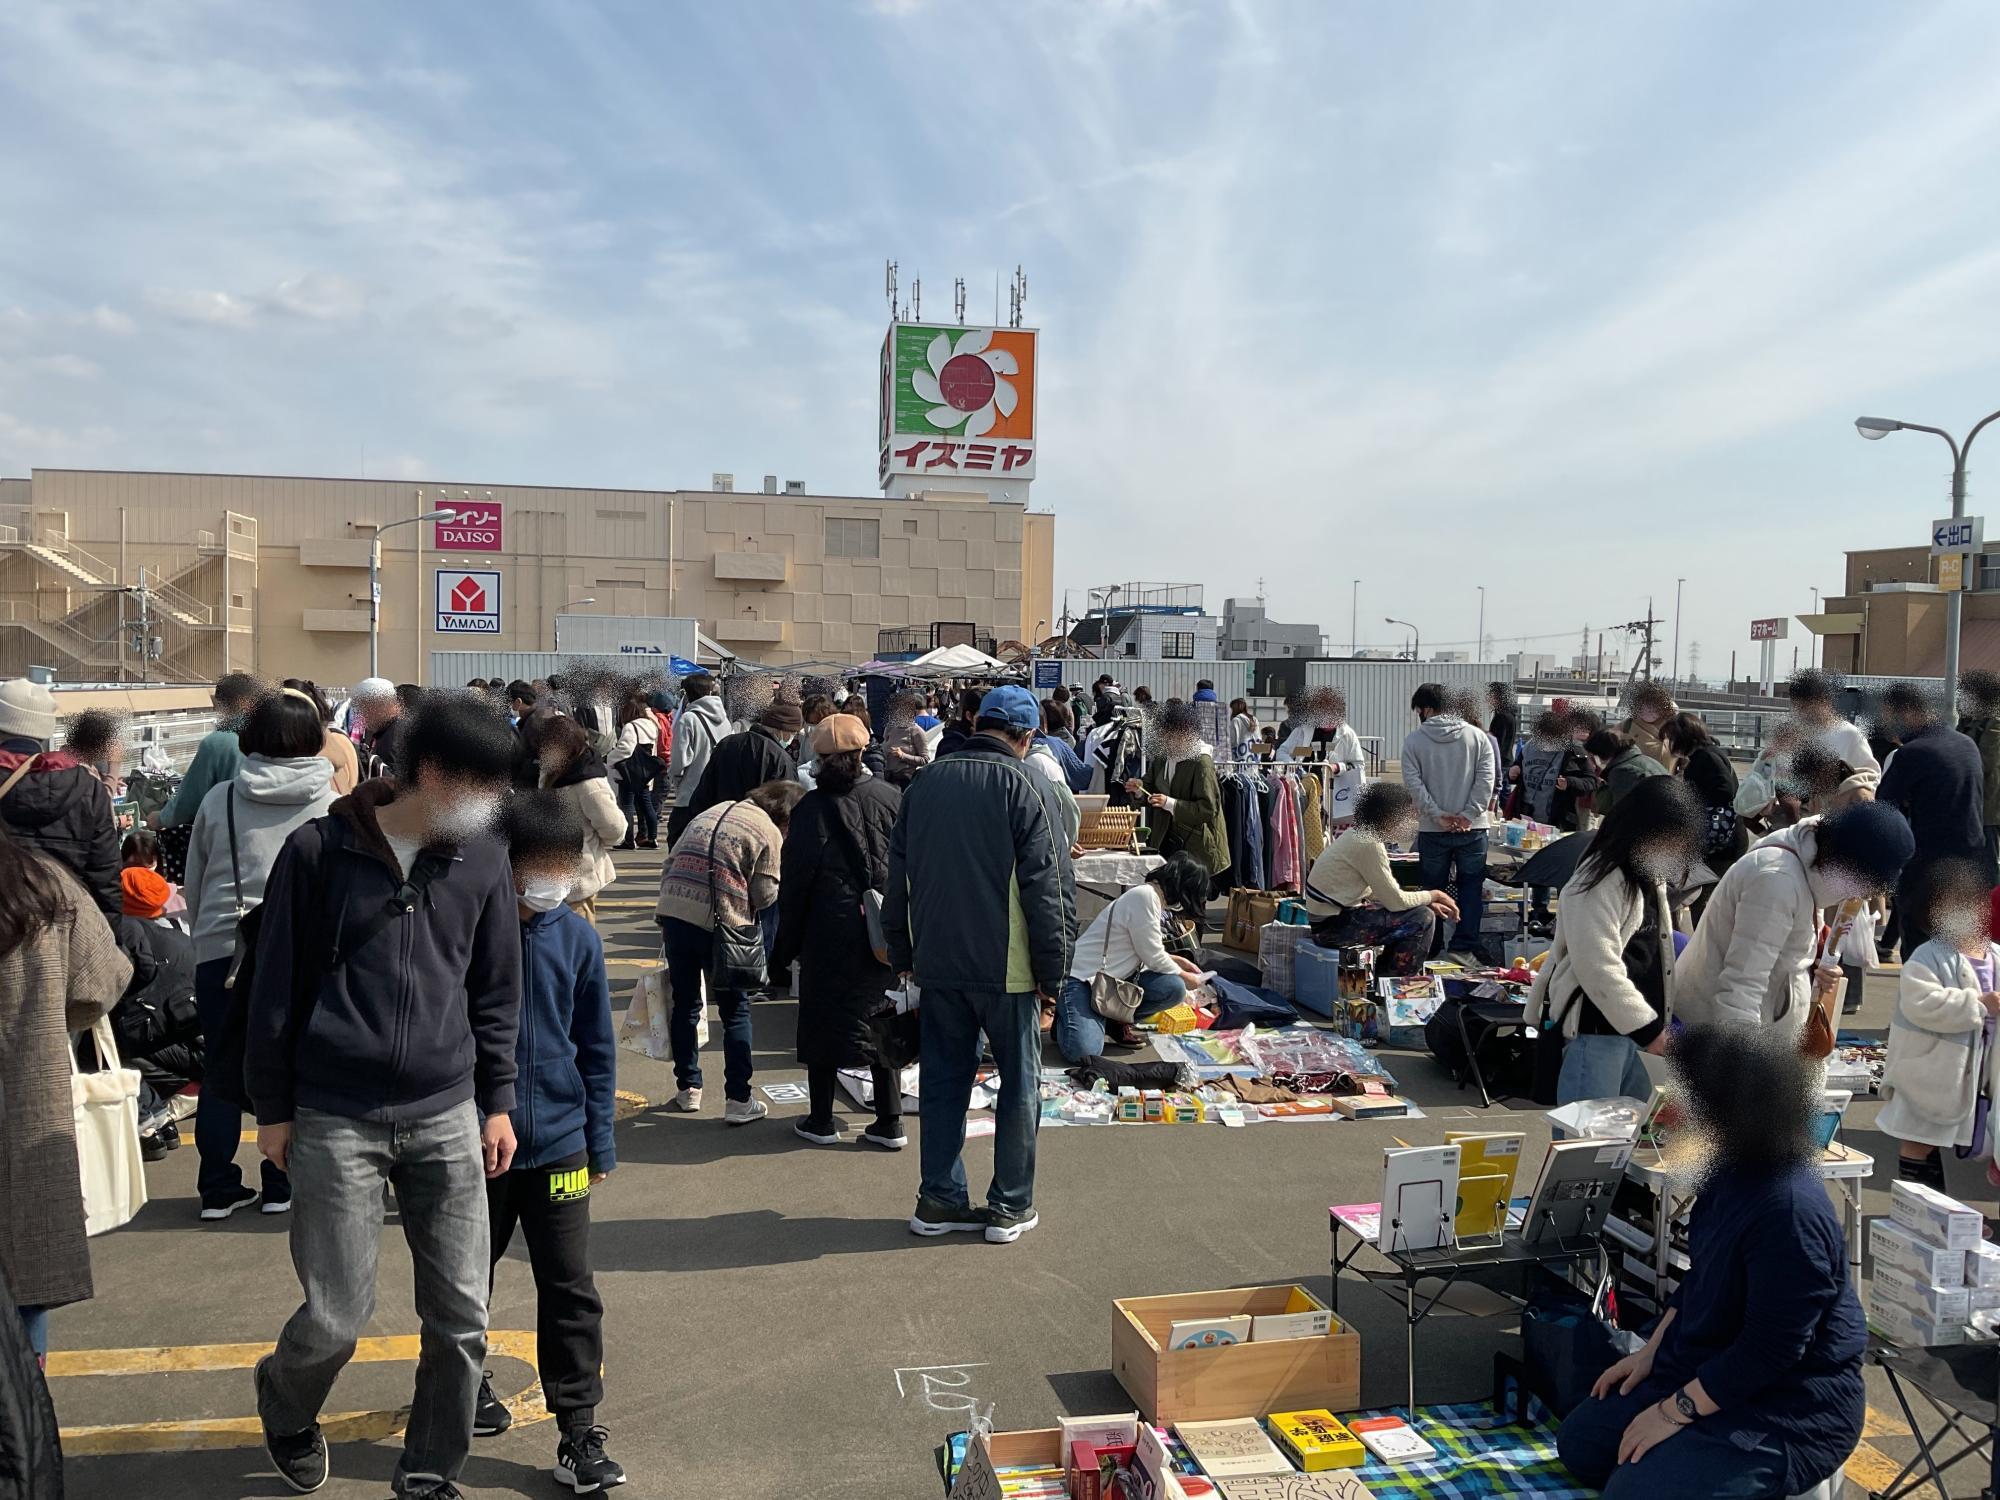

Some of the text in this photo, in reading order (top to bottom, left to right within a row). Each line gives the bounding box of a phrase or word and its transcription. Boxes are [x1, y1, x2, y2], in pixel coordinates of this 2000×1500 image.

[894, 441, 1033, 471] イズミヤ
[443, 531, 495, 543] DAISO
[1948, 525, 1971, 547] 出口
[442, 616, 495, 629] YAMADA
[1752, 622, 1776, 637] タマホーム
